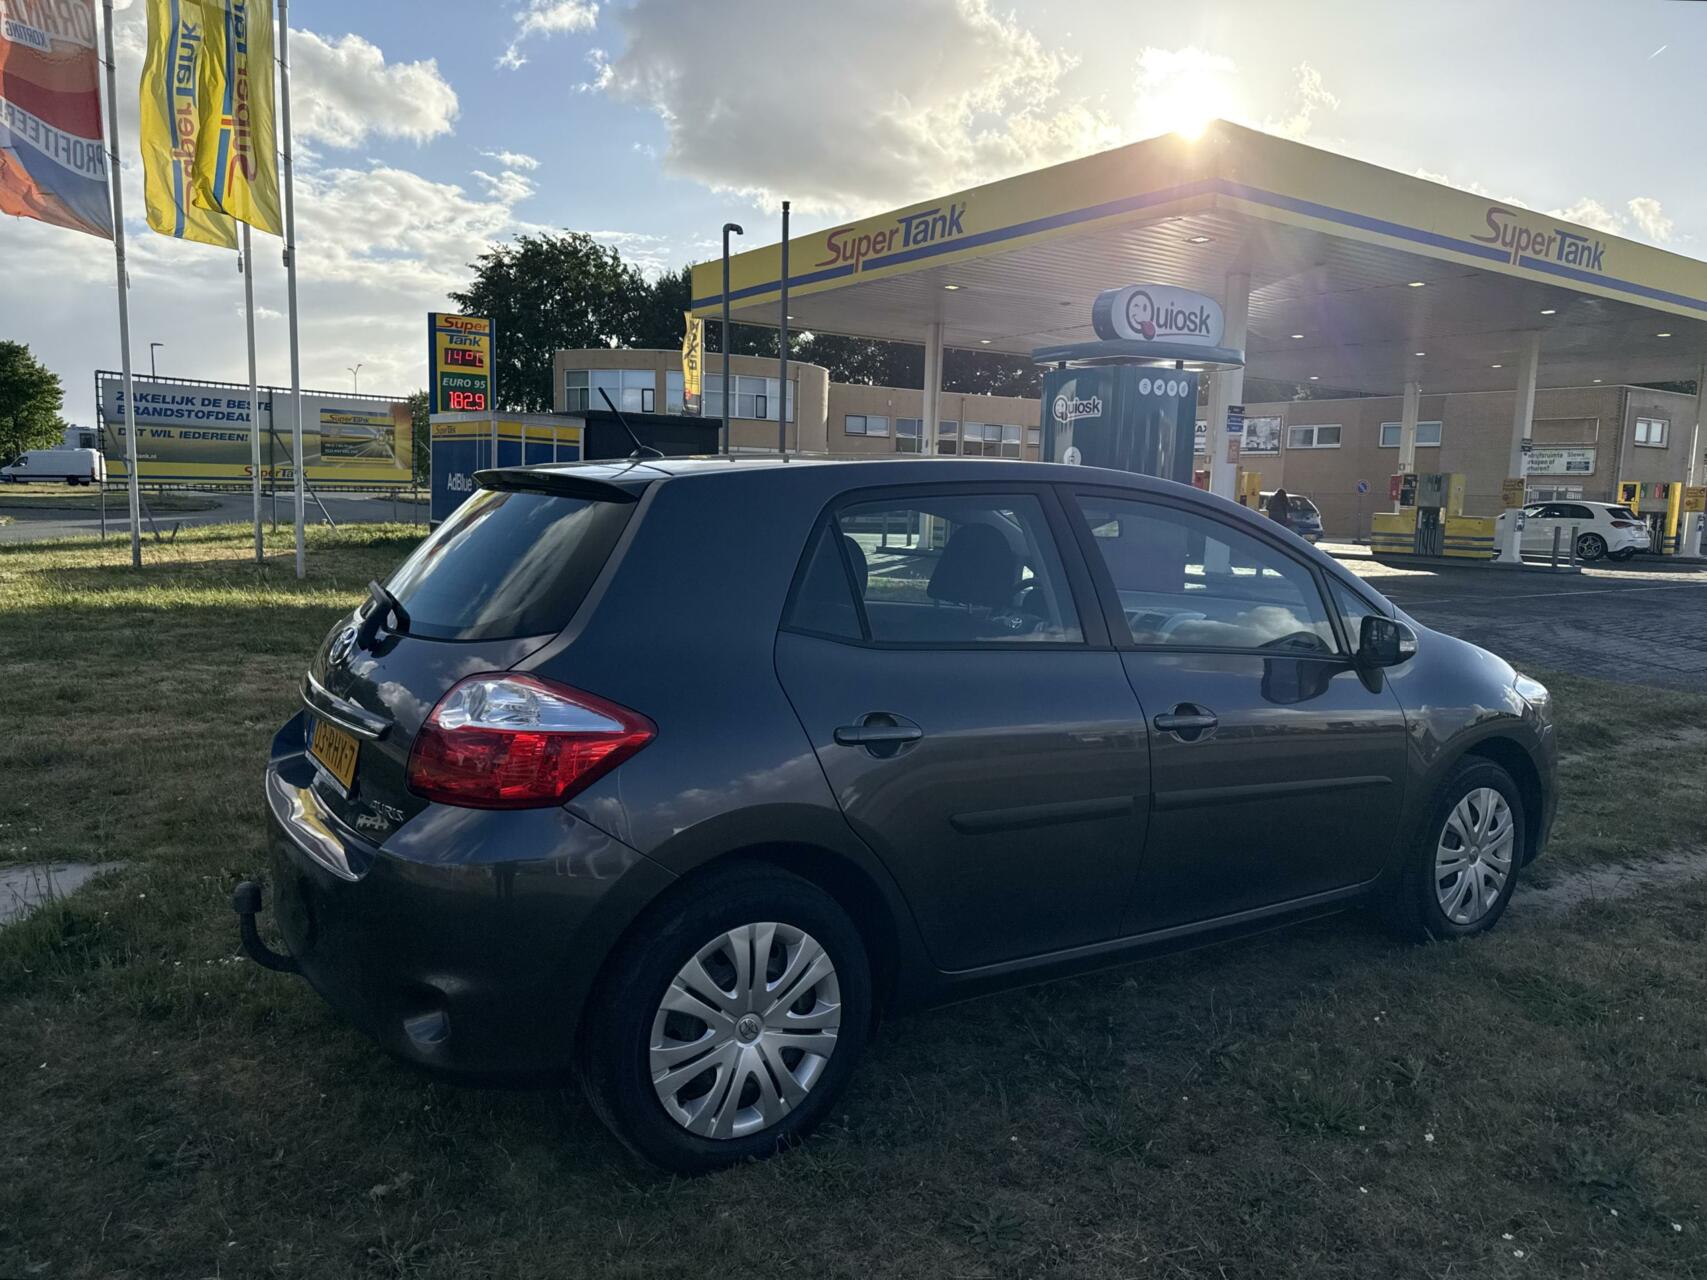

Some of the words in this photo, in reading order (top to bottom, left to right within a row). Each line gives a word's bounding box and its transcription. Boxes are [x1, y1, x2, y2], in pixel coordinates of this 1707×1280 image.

[814, 203, 966, 273] SuperTank
[1470, 206, 1606, 271] SuperTank
[1125, 290, 1210, 340] Quiosk
[436, 316, 488, 334] Super
[445, 333, 482, 346] Tank
[442, 378, 471, 387] EURO
[474, 379, 486, 388] 95
[201, 398, 222, 408] DE
[1054, 395, 1101, 421] Quiosk
[118, 427, 146, 437] DT
[151, 429, 174, 438] WIL
[179, 431, 248, 442] IEDEREEN!
[447, 472, 472, 492] AdBlue
